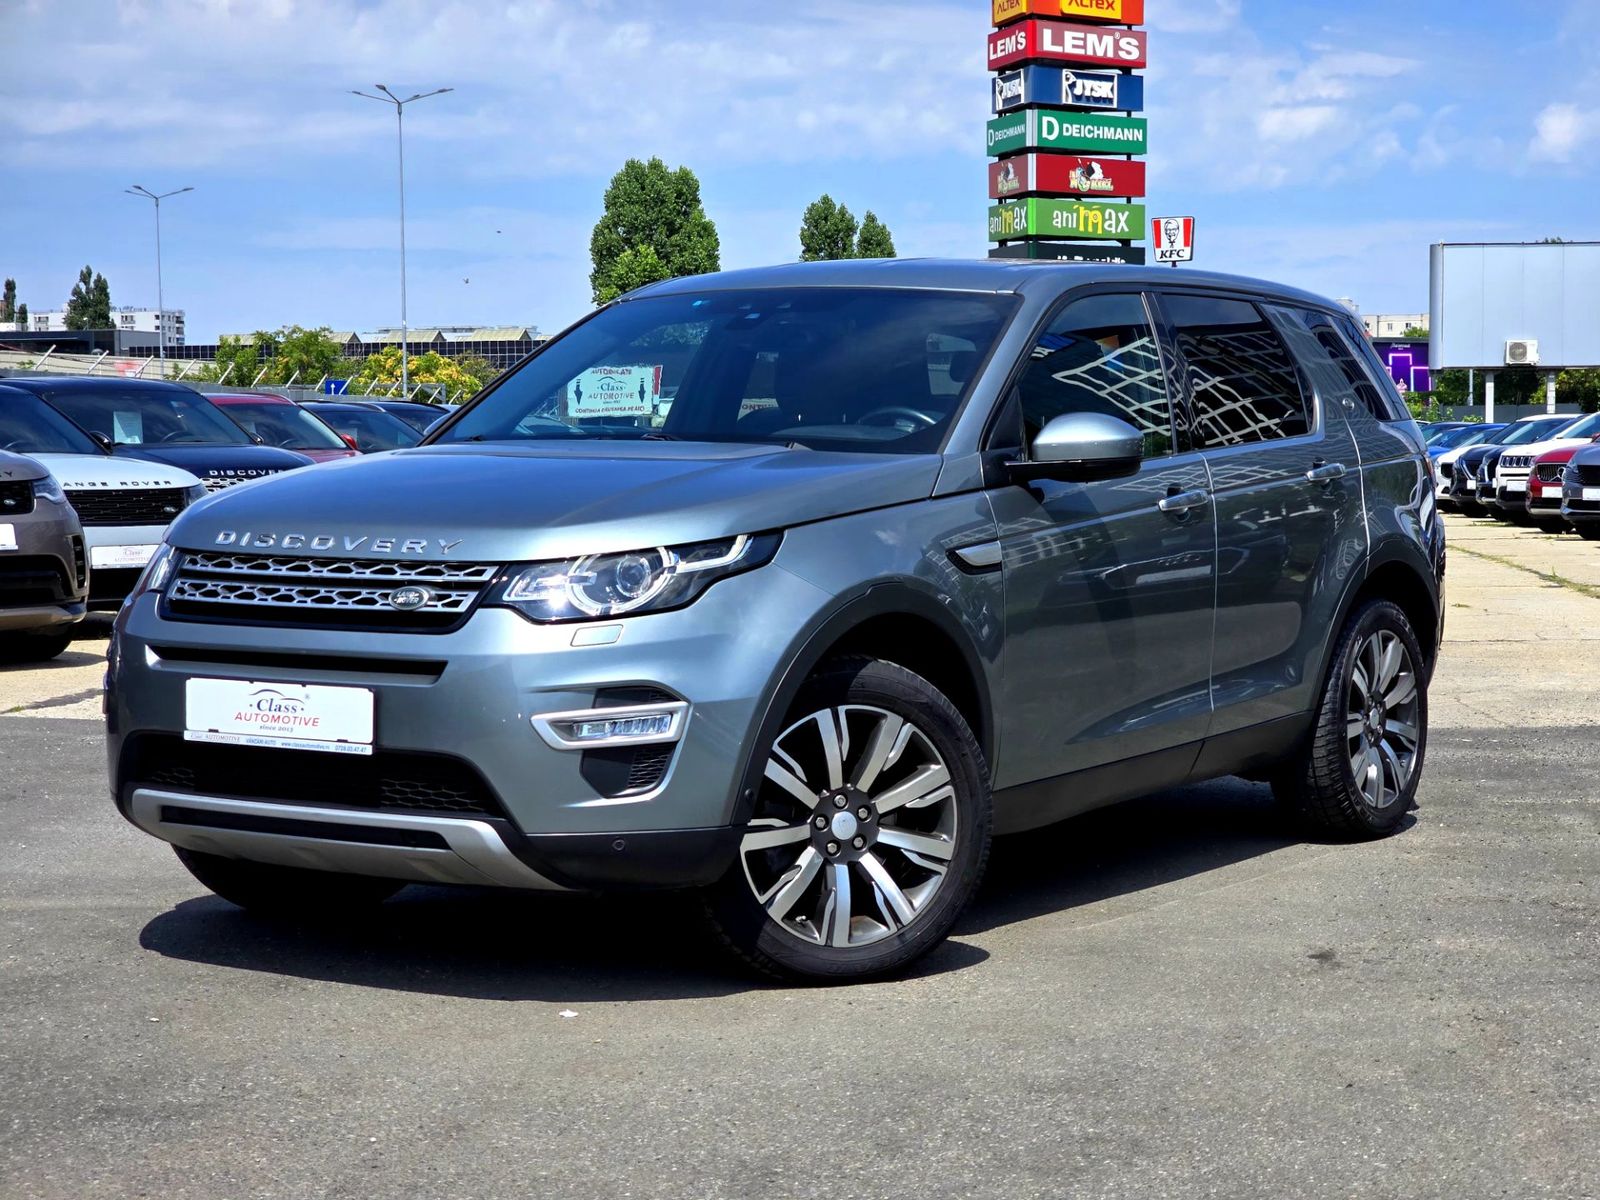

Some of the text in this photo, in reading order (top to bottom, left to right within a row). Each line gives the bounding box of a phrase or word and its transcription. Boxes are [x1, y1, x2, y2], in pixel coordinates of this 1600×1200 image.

[989, 31, 1026, 60] LEM'S
[1073, 78, 1115, 100] JYSK
[995, 123, 1026, 141] DEICHMANN
[1042, 116, 1143, 142] D DEICHMANN
[989, 205, 1027, 234] animax
[1052, 205, 1130, 234] animax
[1159, 249, 1184, 259] KFC
[588, 392, 635, 400] AUTOMOTIVE
[600, 382, 624, 392] Class
[214, 530, 465, 554] DISCOVERY
[256, 698, 298, 713] Class
[234, 711, 320, 727] AUTOMOTIVE
[259, 724, 276, 732] since
